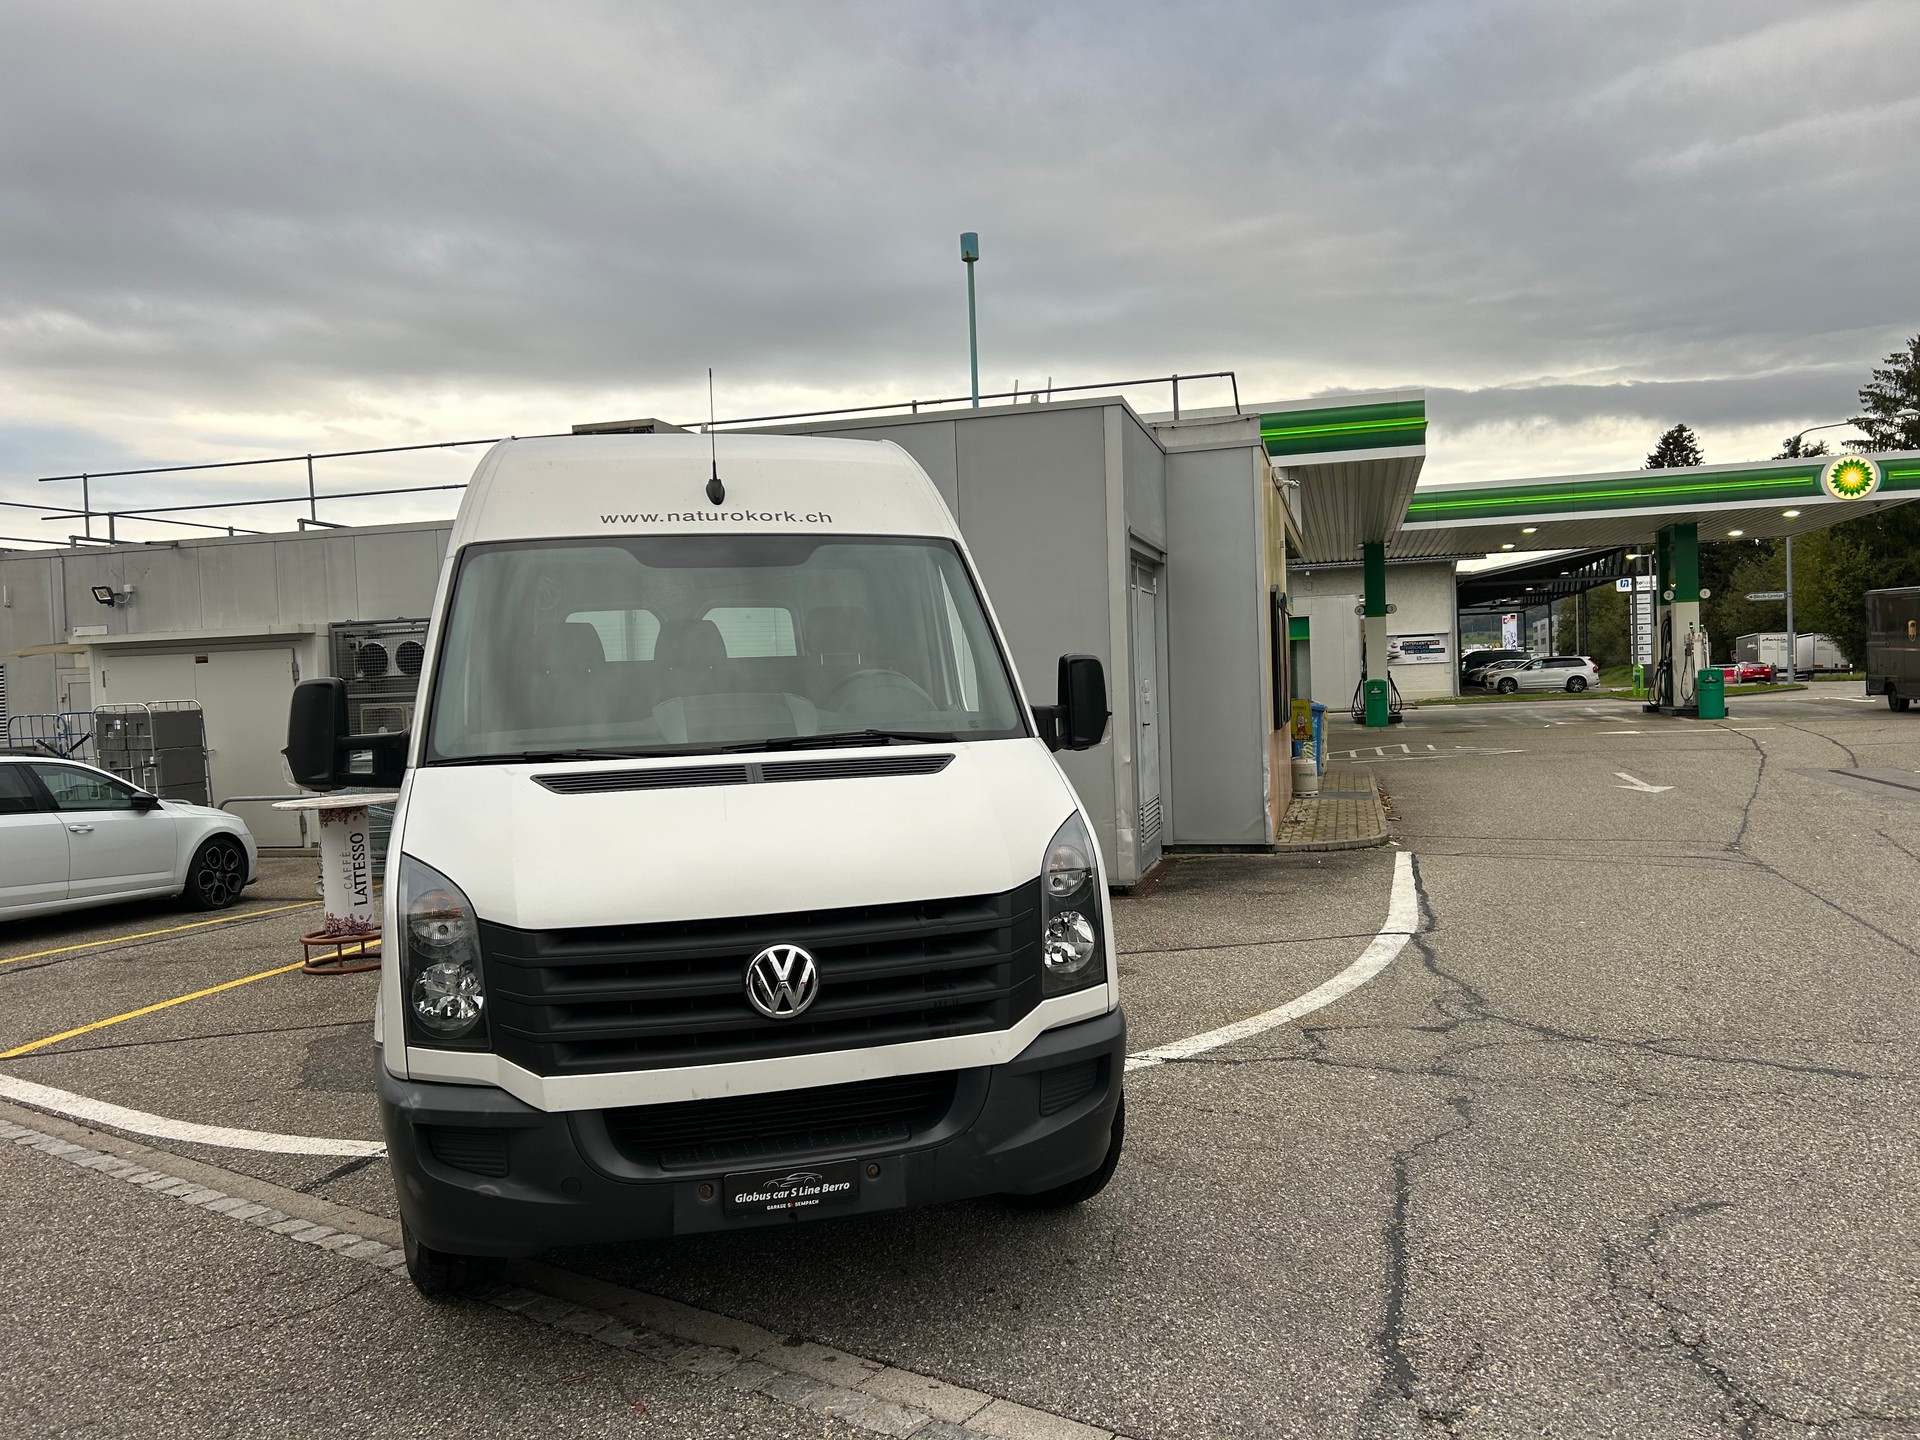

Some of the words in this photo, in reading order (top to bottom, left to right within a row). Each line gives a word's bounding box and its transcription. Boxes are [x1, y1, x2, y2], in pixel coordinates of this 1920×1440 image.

[600, 510, 833, 524] www.naturokork.ch
[339, 851, 353, 890] CAFFÈ
[350, 832, 368, 907] LATTESSO
[735, 1192, 771, 1204] Globus
[772, 1190, 790, 1199] car
[790, 1188, 798, 1197] S
[799, 1185, 820, 1196] Line
[822, 1182, 850, 1193] Berro
[766, 1203, 786, 1211] GARAGE
[795, 1199, 819, 1207] SEMPACH
